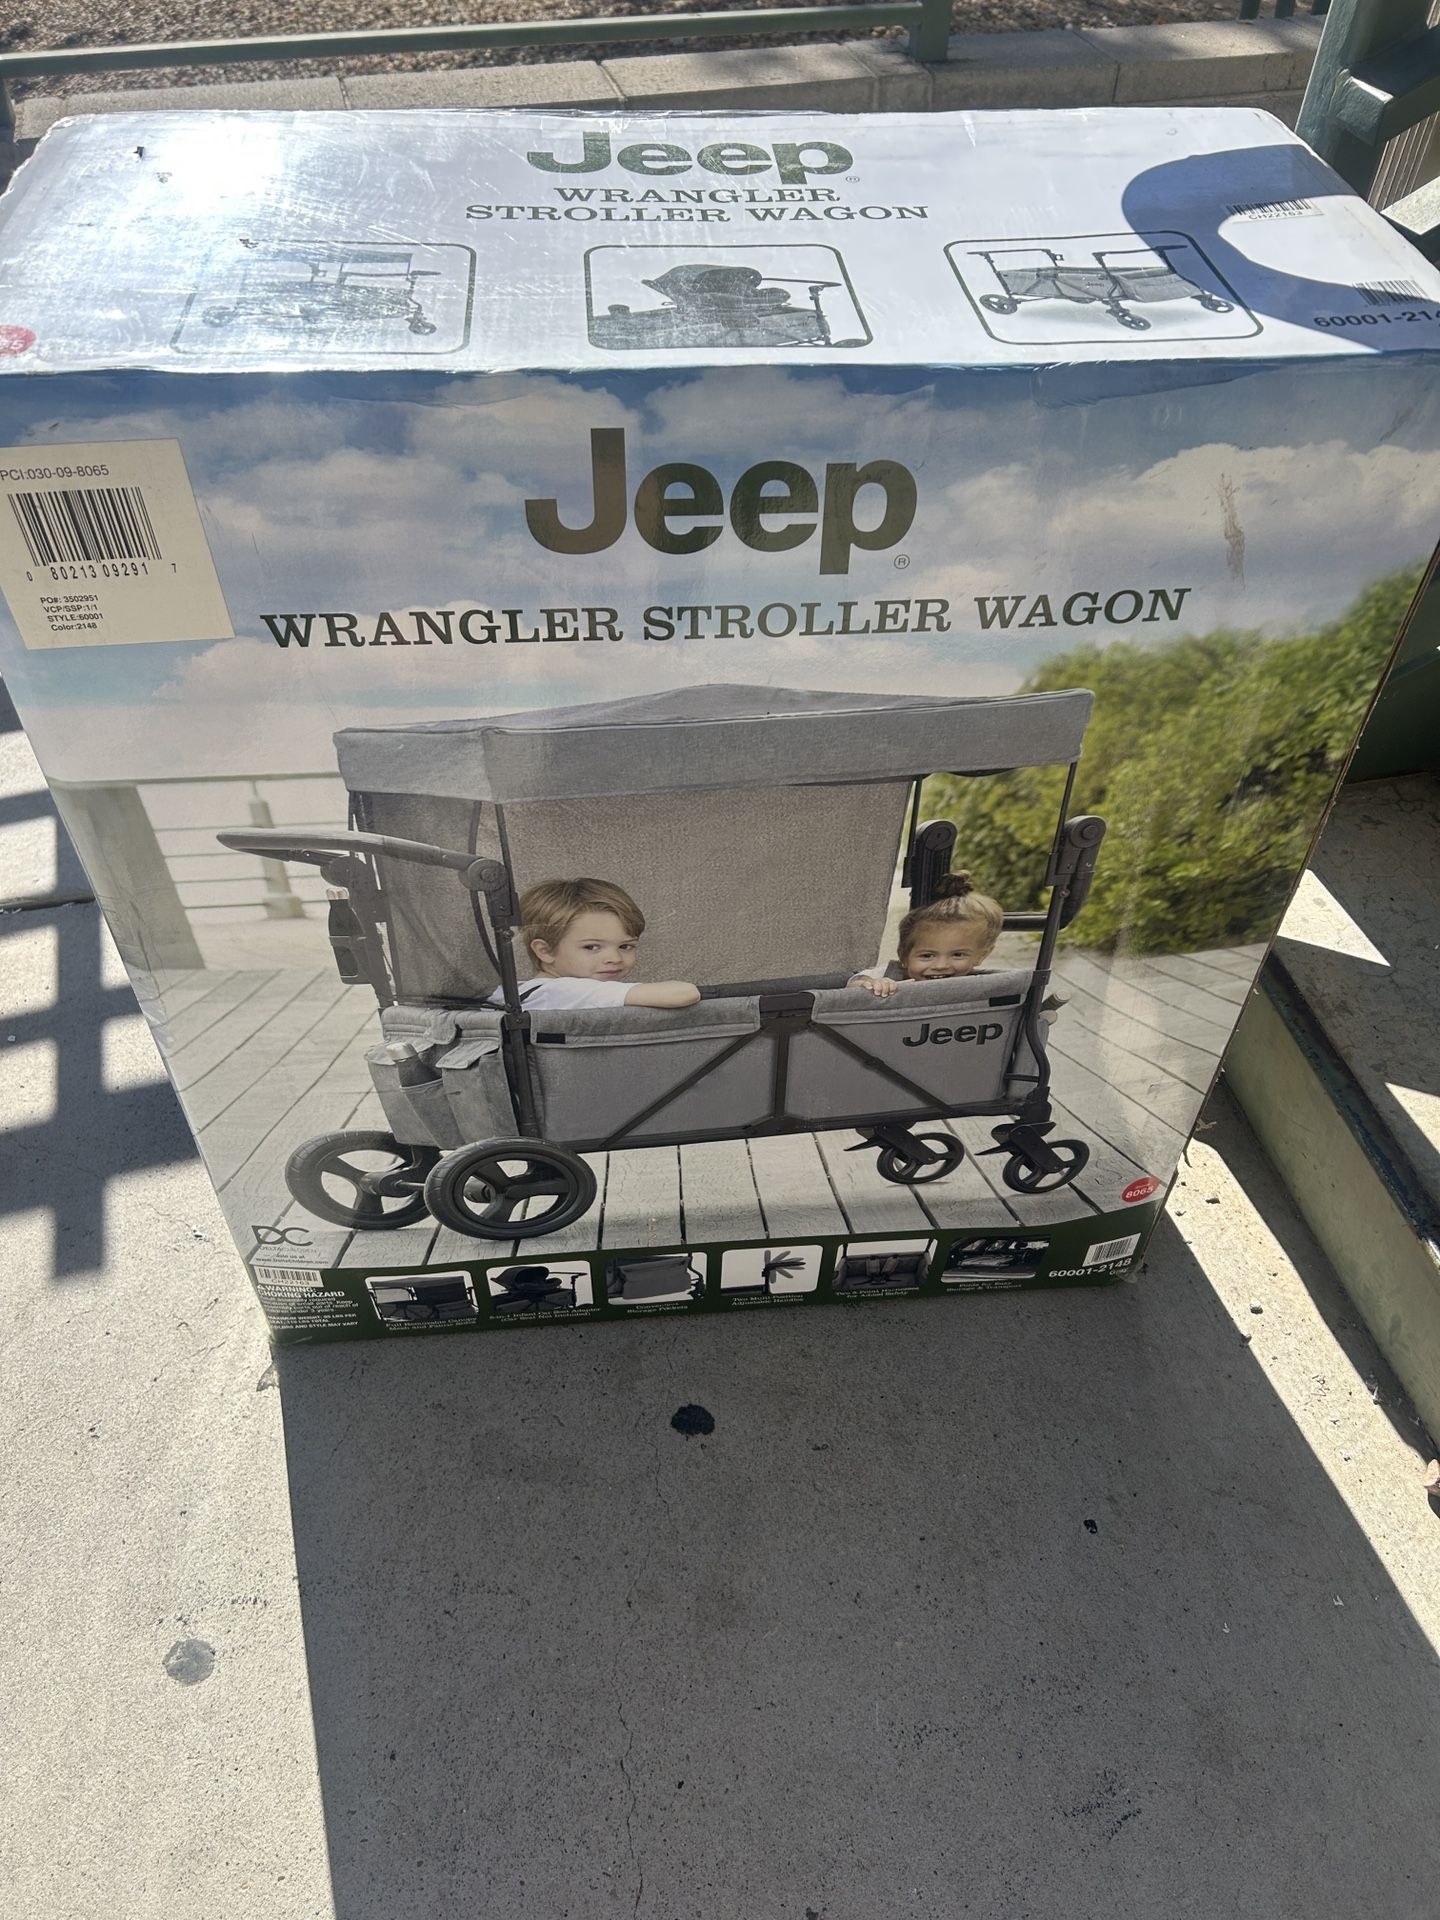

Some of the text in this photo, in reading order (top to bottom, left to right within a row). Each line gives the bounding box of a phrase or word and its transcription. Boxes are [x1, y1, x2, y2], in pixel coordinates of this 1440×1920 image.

[526, 131, 854, 185] Jeep
[553, 187, 841, 203] WRANGLER
[465, 204, 929, 222] STROLLER WAGON
[0, 464, 109, 481] PCI:030-09-8065
[525, 427, 918, 575] Jeep
[26, 561, 177, 581] 0 80213 09291 7
[63, 594, 99, 603] 3502951
[260, 587, 1191, 649] WRANGLER STROLLER WAGON
[902, 1022, 1003, 1048] Jeep
[1125, 1185, 1154, 1199] 8065
[1048, 1258, 1132, 1278] 60001-2148
